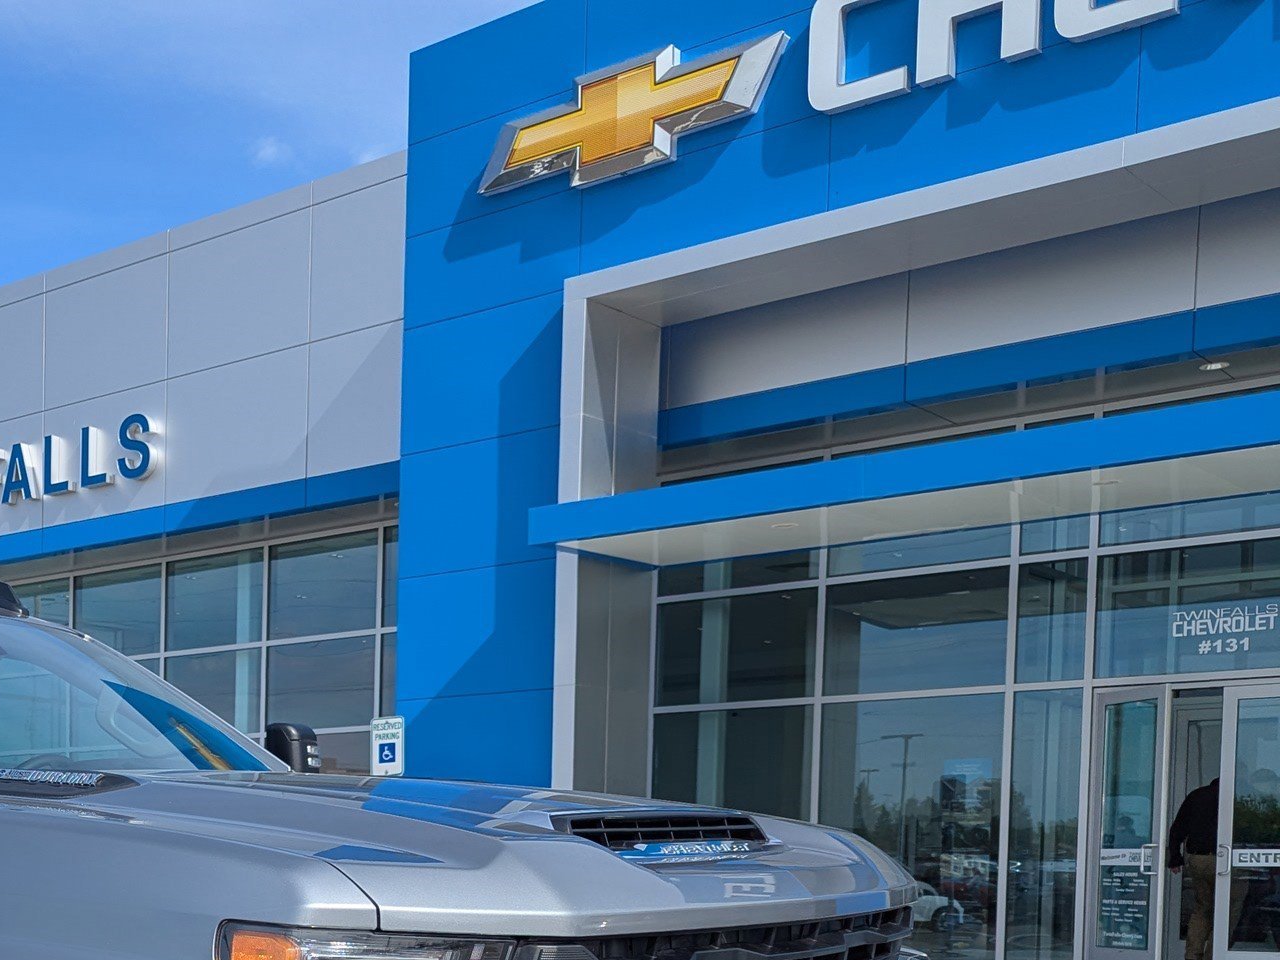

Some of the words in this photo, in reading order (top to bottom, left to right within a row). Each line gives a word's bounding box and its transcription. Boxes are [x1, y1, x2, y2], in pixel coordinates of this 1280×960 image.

[1172, 613, 1279, 638] CHEVROLET
[1198, 636, 1250, 655] #131
[373, 721, 402, 731] RESERVED
[375, 732, 400, 741] PARKING
